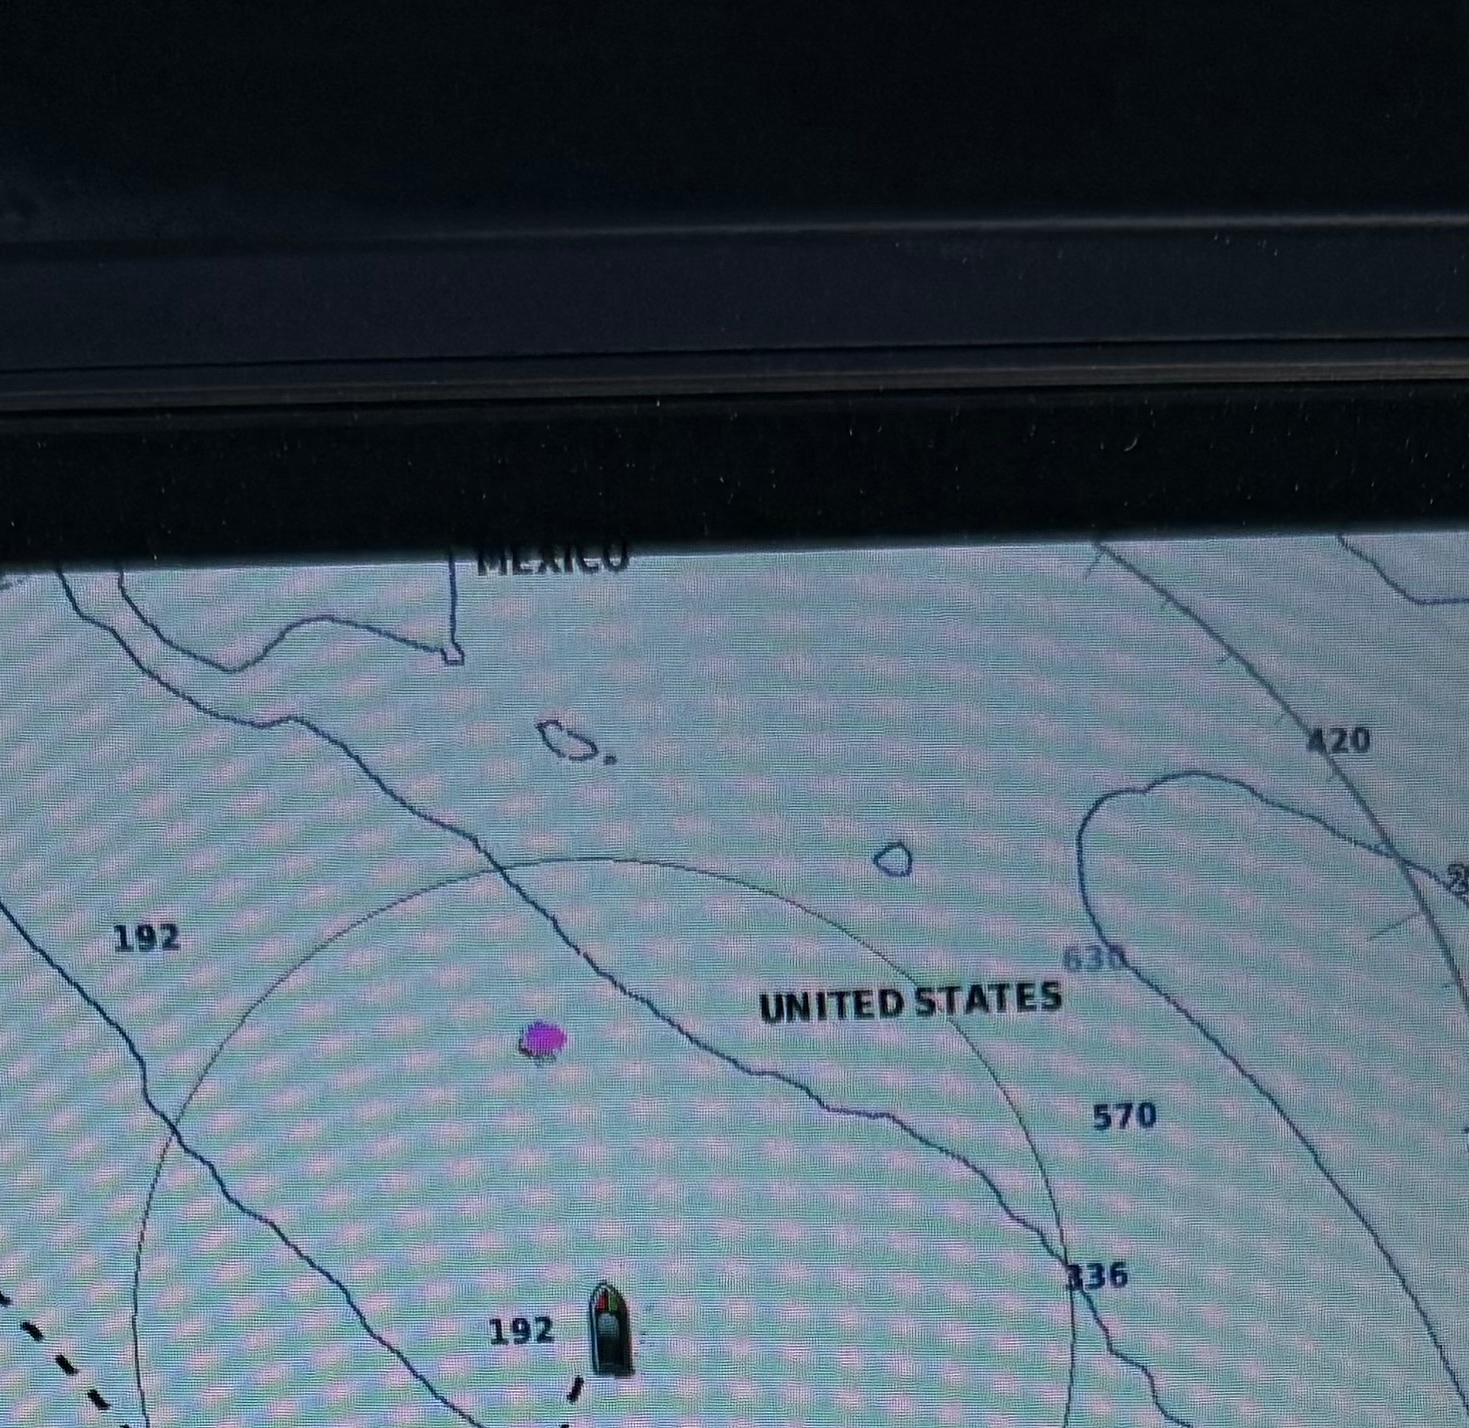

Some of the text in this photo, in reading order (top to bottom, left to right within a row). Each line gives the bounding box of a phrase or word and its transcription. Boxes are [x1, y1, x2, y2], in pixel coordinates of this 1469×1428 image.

[477, 541, 630, 577] MEXICO
[1307, 727, 1372, 755] 420
[113, 923, 182, 954] 192
[1062, 943, 1127, 973] 630
[759, 980, 1064, 1024] UNITED STATES
[1093, 1101, 1157, 1131] 570
[1066, 1261, 1129, 1291] 336
[488, 1316, 556, 1346] 192
